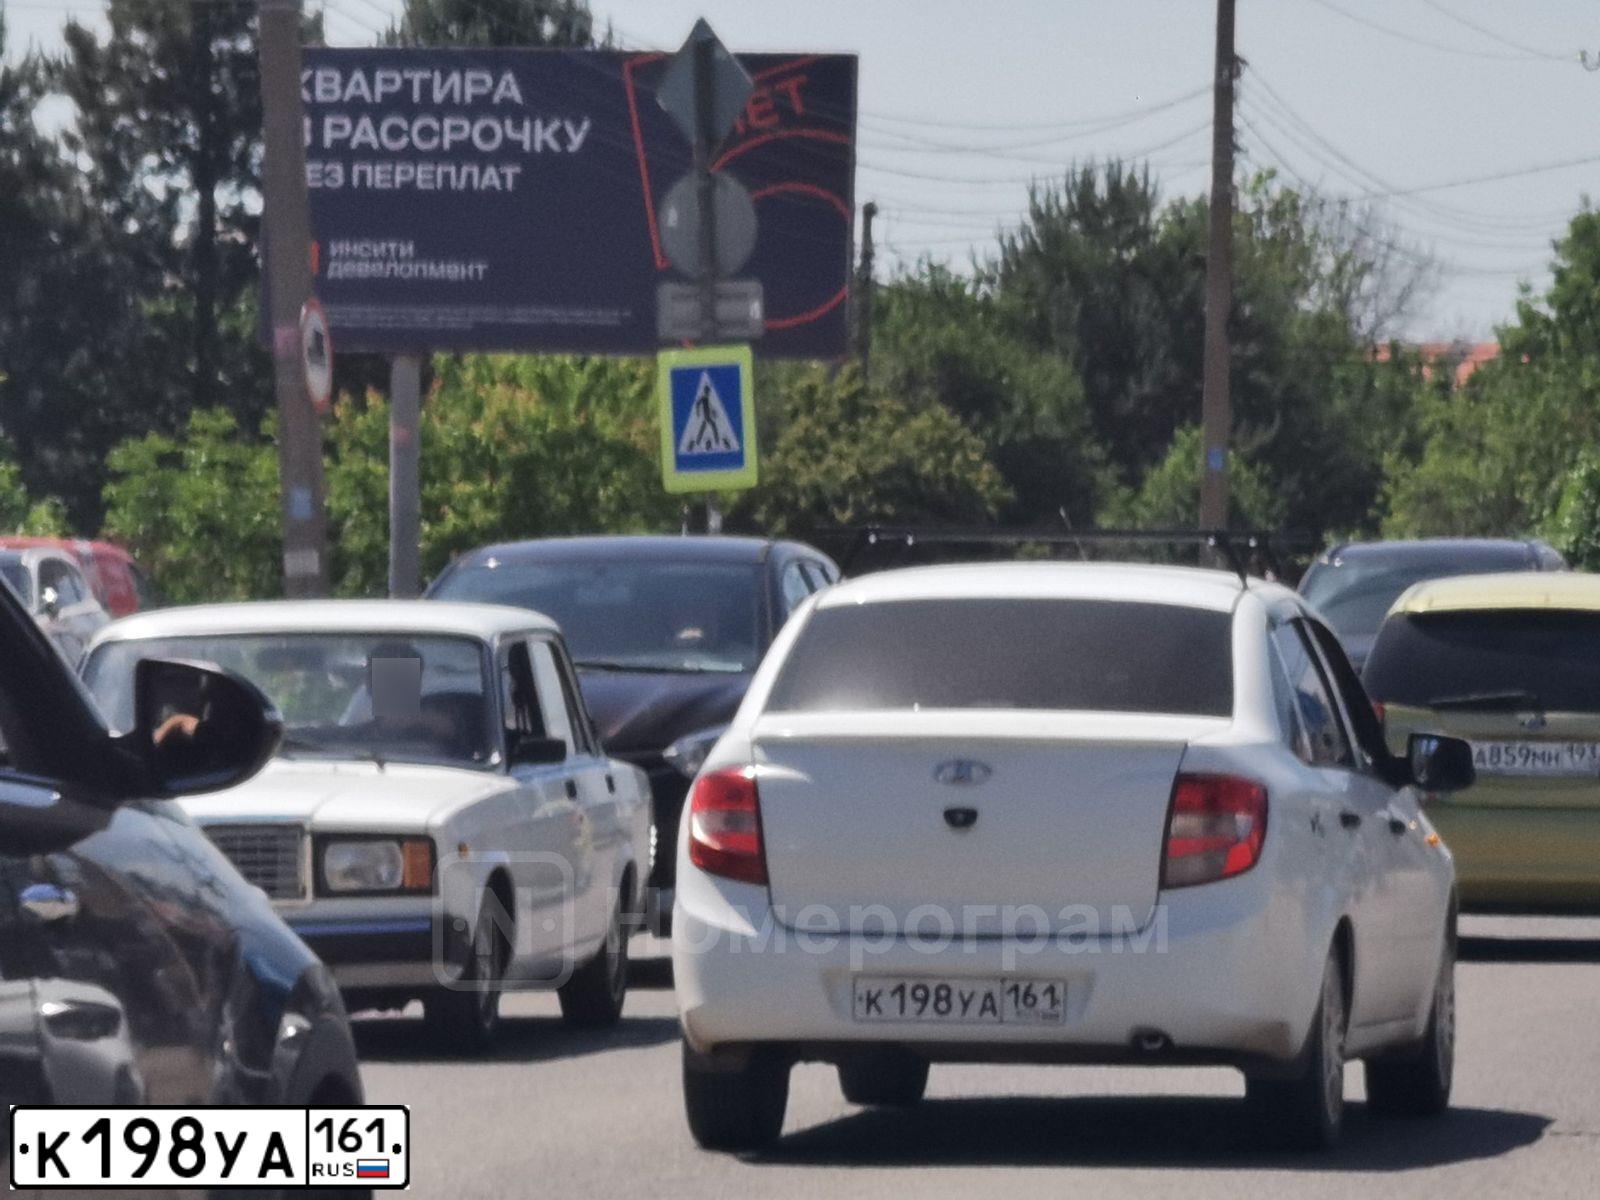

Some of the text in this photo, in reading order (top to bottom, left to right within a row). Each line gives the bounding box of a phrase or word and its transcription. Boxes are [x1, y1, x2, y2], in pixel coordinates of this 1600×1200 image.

[733, 75, 808, 135] ЕТ
[323, 115, 590, 152] РАССРОЧКУ
[305, 162, 522, 191] ЕЗ ПЕРЕПЛАТ
[865, 982, 1056, 1017] К198УА 161
